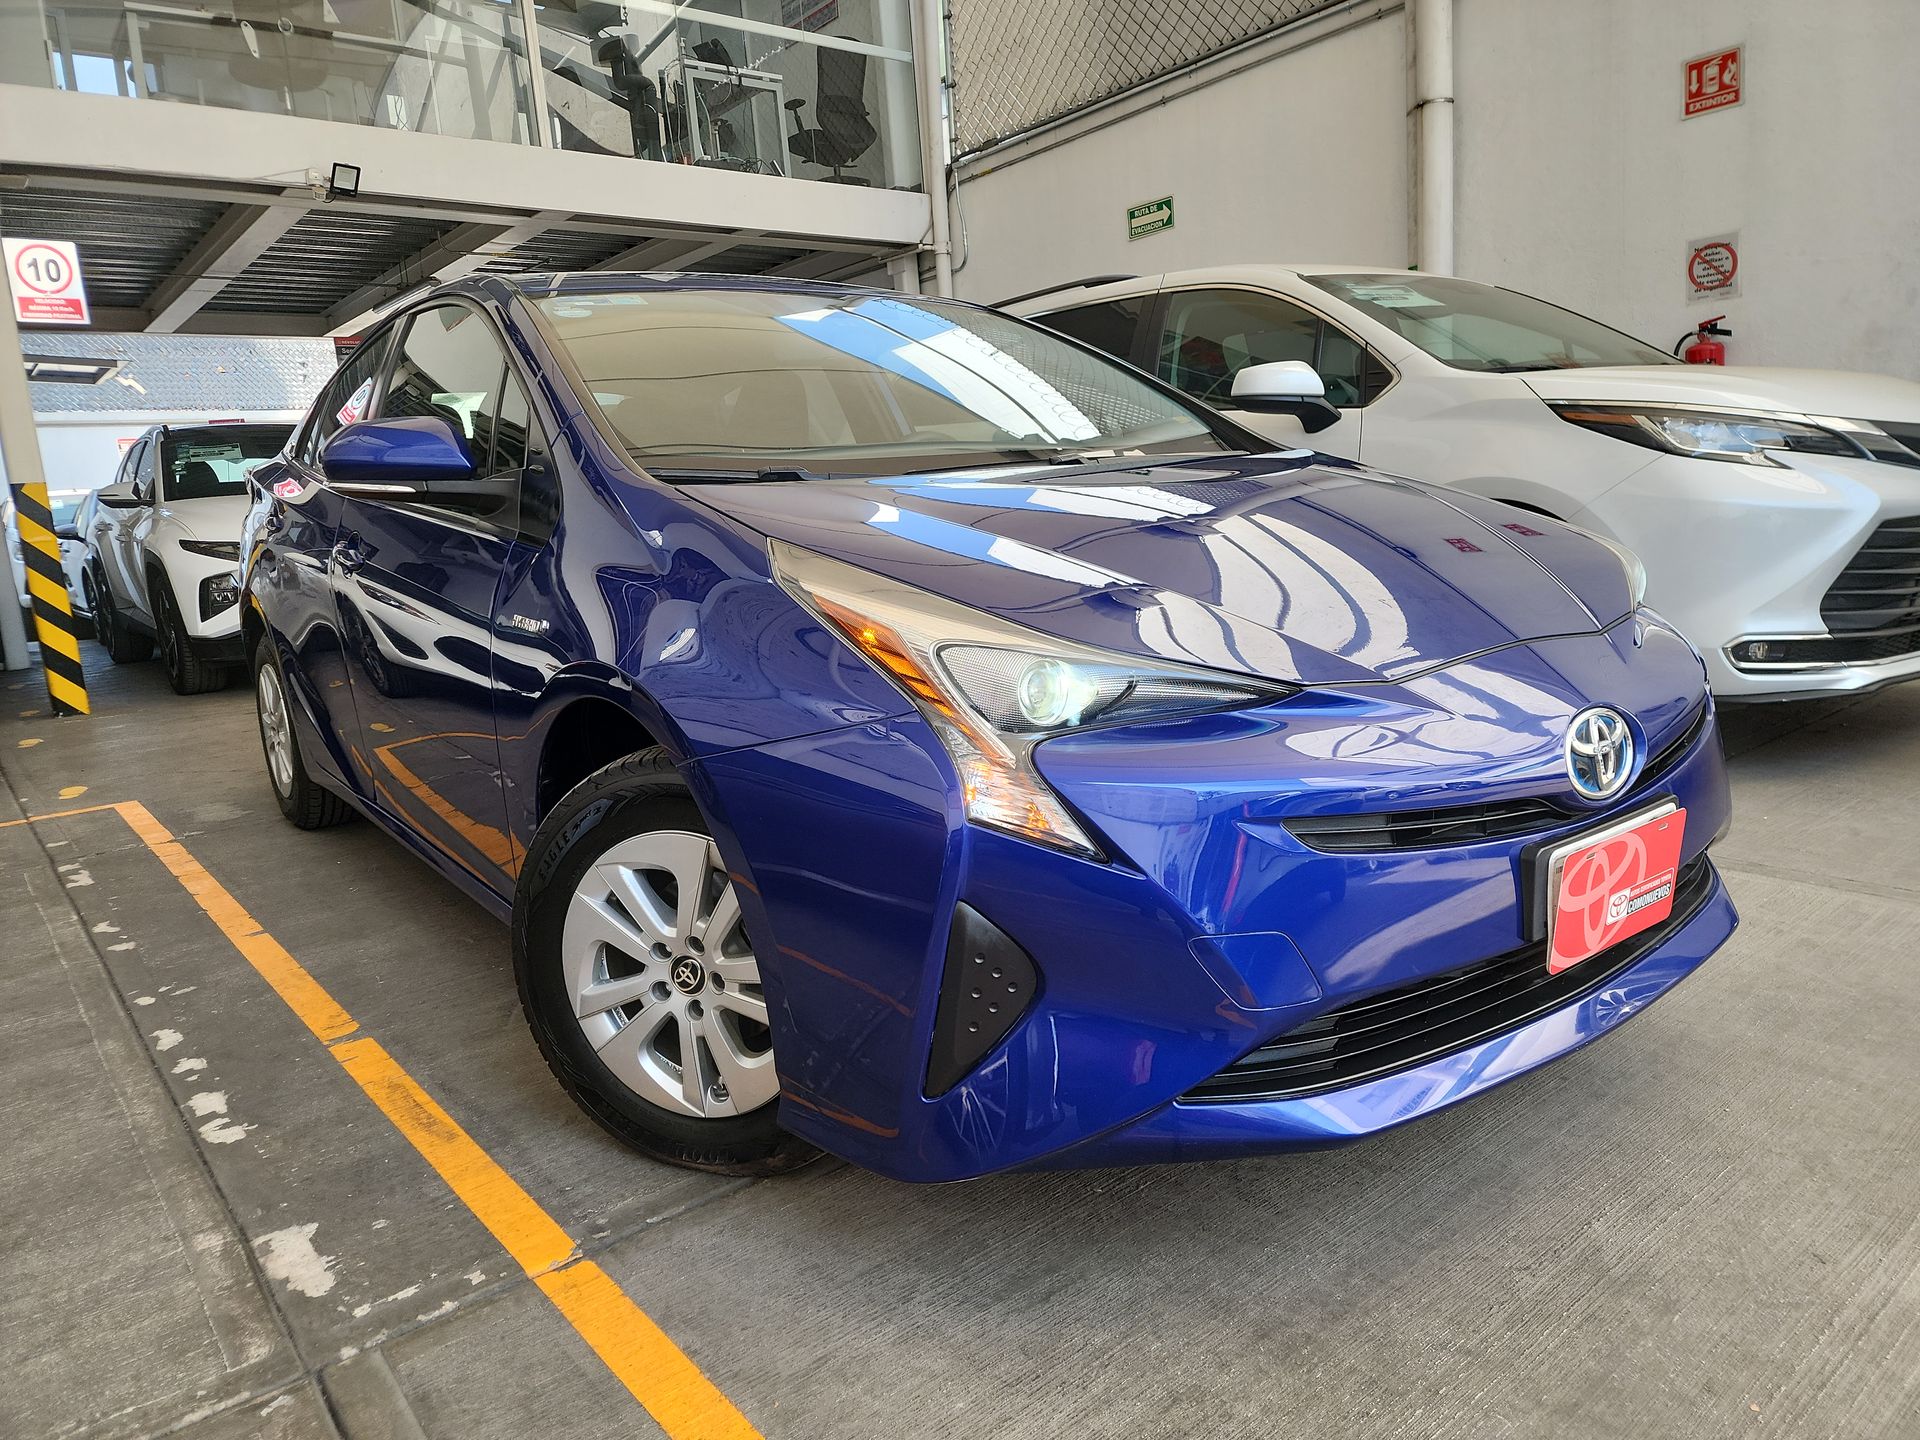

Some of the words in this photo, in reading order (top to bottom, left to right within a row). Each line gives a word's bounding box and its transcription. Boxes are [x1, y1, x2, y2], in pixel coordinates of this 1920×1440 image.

[1689, 92, 1736, 112] EXTINTOR
[1134, 207, 1150, 217] RUTA
[1150, 204, 1158, 213] DE
[27, 257, 61, 283] 10
